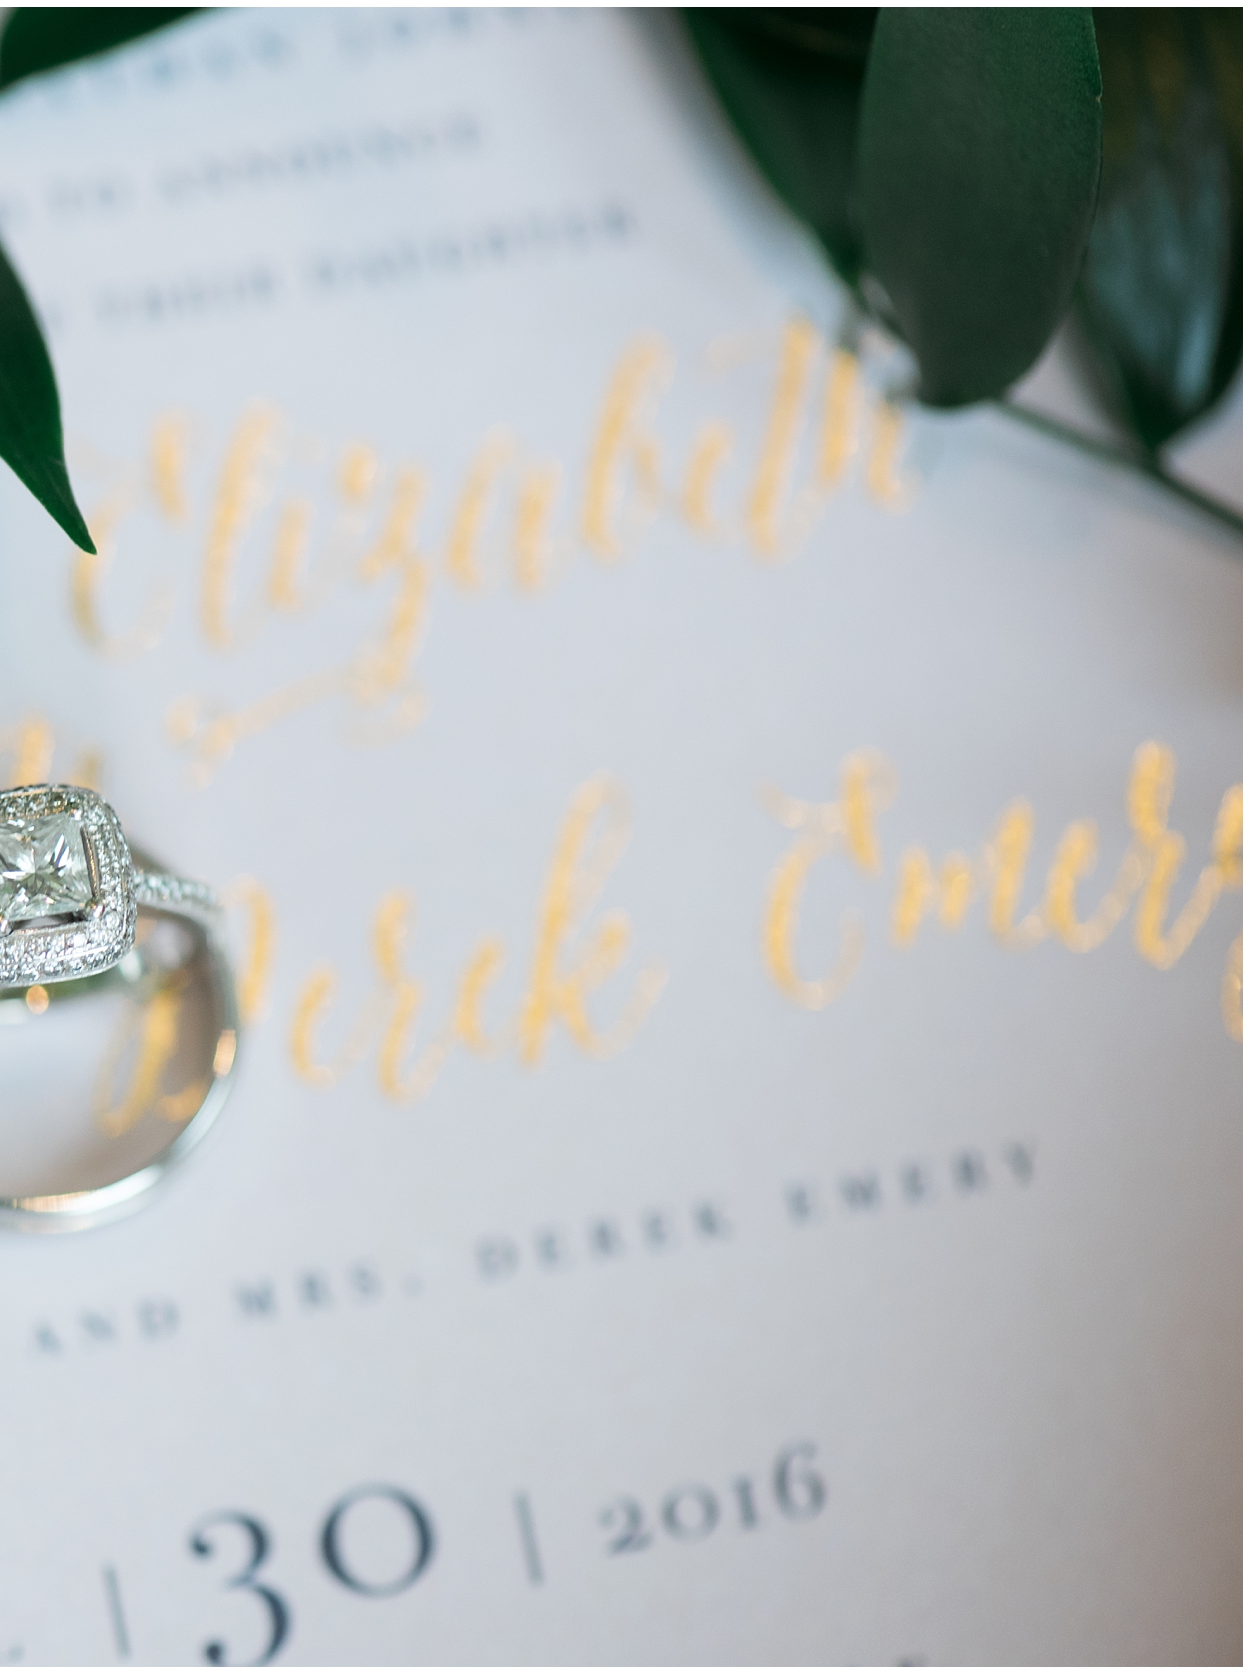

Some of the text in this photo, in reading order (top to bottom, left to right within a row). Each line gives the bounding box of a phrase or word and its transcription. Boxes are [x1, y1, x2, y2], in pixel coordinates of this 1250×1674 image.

[68, 316, 918, 704] Elizabeth
[30, 1296, 183, 1360] AND
[230, 1259, 421, 1324] MRS.
[472, 1196, 736, 1284] DEREK
[782, 1138, 1039, 1228] EMERY
[182, 1480, 442, 1667] 30
[596, 1438, 830, 1559] 2016
